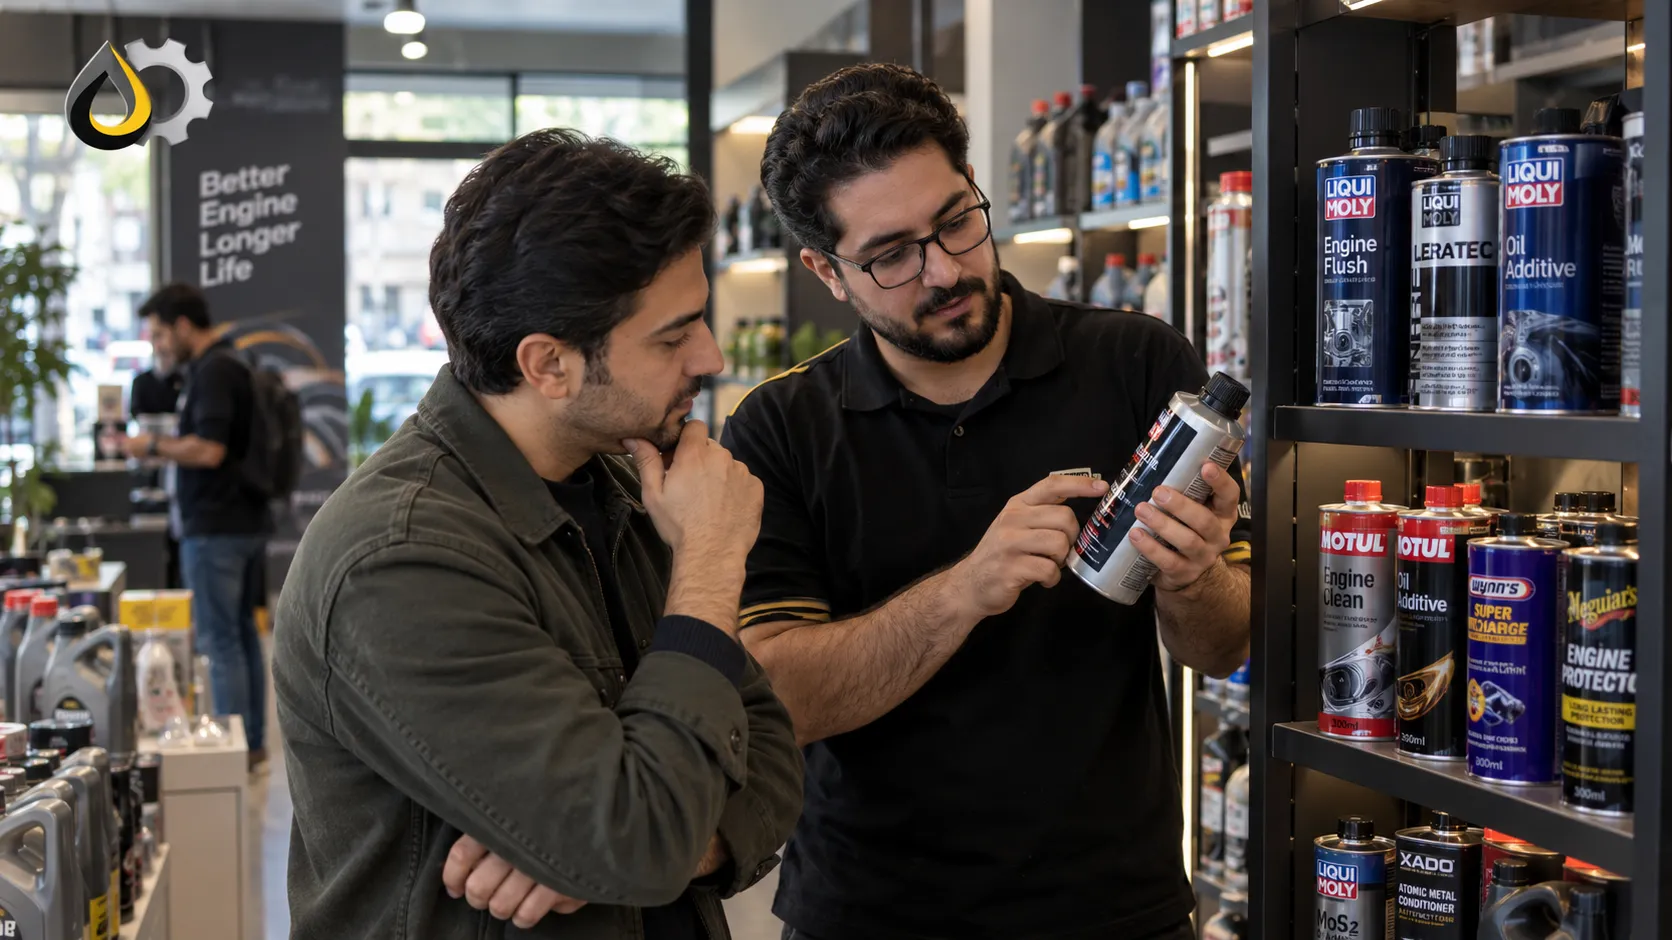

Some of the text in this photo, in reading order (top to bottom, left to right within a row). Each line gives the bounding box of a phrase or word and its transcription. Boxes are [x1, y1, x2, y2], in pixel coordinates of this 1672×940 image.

[200, 163, 291, 198] Better
[1508, 161, 1559, 183] LIQUI
[1327, 178, 1371, 198] LIQUI
[1507, 182, 1560, 206] MOLY
[200, 192, 298, 227] Engine
[1326, 198, 1373, 218] MOLY
[1423, 195, 1459, 210] LIQUI
[1423, 211, 1458, 226] MOLY
[200, 221, 302, 257] Longer
[1324, 234, 1378, 258] Engine
[1505, 234, 1526, 256] Oil
[200, 255, 254, 288] Life
[1324, 255, 1368, 275] Flush
[1505, 257, 1577, 280] Additive
[1321, 530, 1384, 553] MOTUL
[1324, 566, 1375, 590] Engine
[1398, 571, 1410, 591] Oil
[1324, 588, 1364, 610] Clean
[1567, 584, 1638, 625] Meguiar's
[1474, 603, 1513, 621] SUPER
[1567, 643, 1632, 671] ENGINE
[1591, 705, 1633, 717] LASTING
[1319, 862, 1355, 882] LIQUI
[1400, 852, 1454, 874] XADO
[1319, 877, 1355, 898] MOLY
[1398, 883, 1457, 902] ATOMIC METAL
[1398, 895, 1455, 914] CONDITIONER
